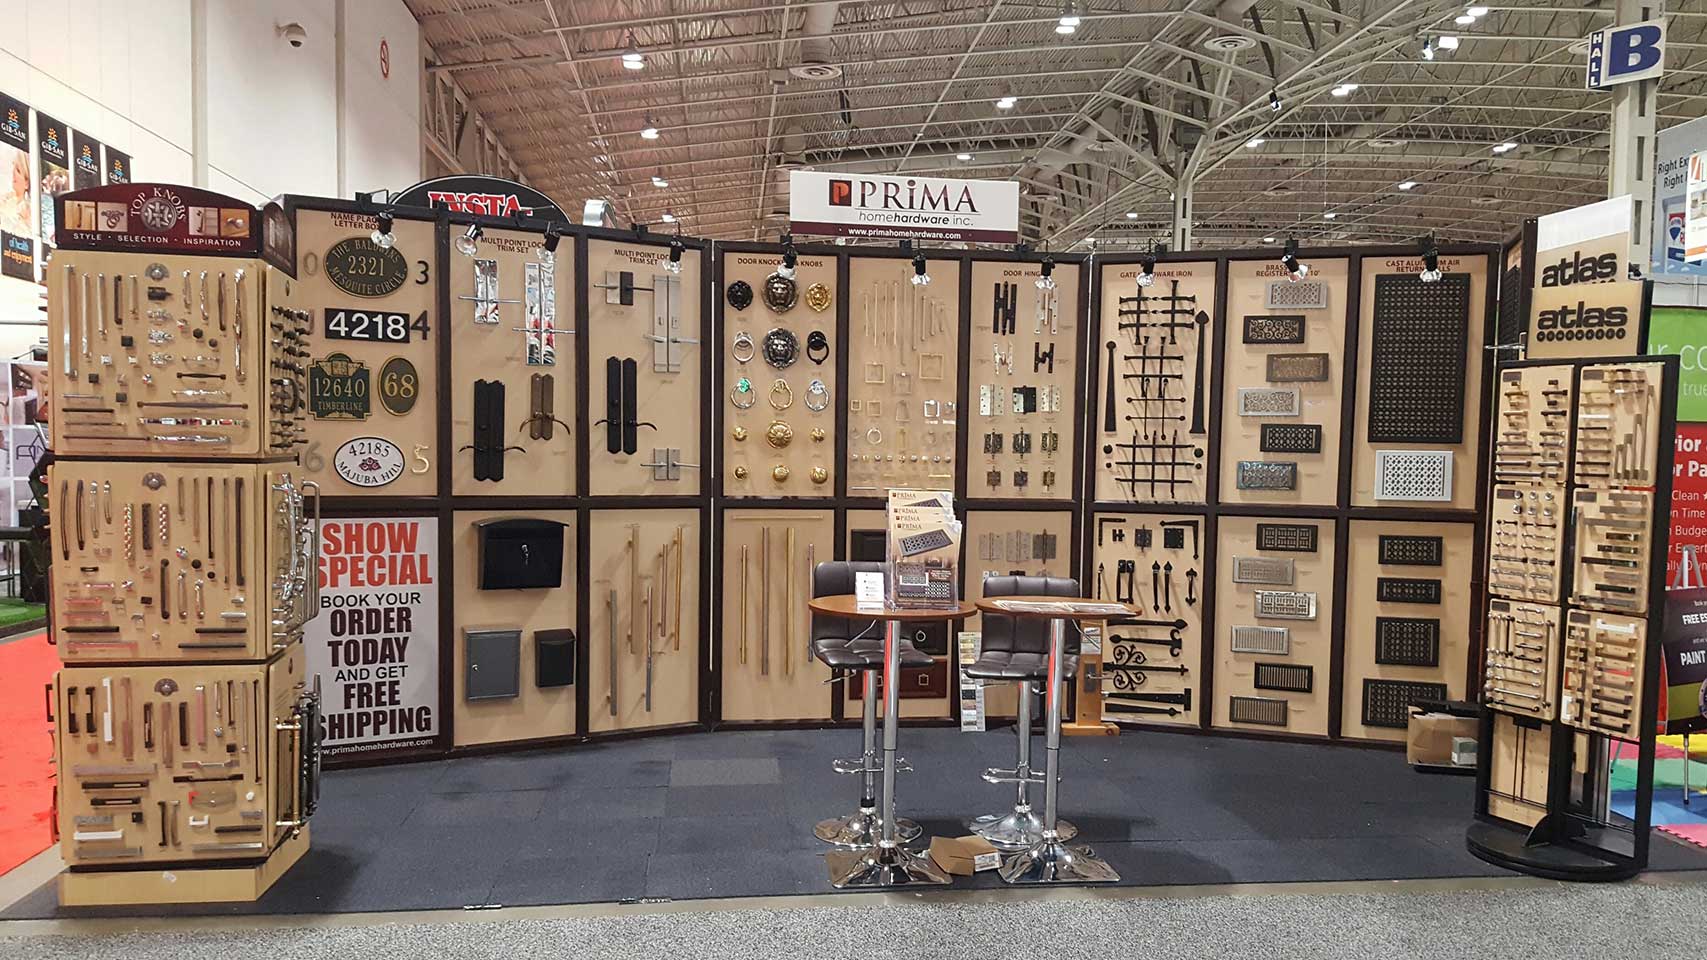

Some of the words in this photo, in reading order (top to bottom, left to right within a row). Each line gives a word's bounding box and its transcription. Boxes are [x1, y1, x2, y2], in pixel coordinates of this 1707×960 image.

[1590, 33, 1602, 86] HALL
[1608, 26, 1661, 76] B
[1658, 160, 1677, 175] Right
[1664, 173, 1683, 189] Right
[131, 192, 146, 217] TOP
[153, 187, 186, 220] KNOBS
[330, 212, 354, 221] NAME
[357, 215, 379, 224] PLAQ
[334, 220, 363, 229] LETTER
[859, 212, 950, 225] homehardware
[952, 215, 974, 226] inc.
[74, 233, 101, 241] STYLE
[118, 235, 168, 244] SELECTION
[184, 238, 241, 247] INSPIRATION
[480, 237, 502, 246] MULTI
[504, 239, 526, 247] POINT
[848, 228, 961, 240] www.primahomehardware.com
[332, 242, 350, 258] THE
[355, 239, 400, 263] BALDINS
[497, 245, 514, 253] TRIM
[516, 246, 529, 254] SET
[614, 249, 634, 257] MULTI
[636, 250, 655, 259] POINT
[348, 255, 384, 276] 2321
[416, 260, 429, 285] 3
[1024, 270, 1042, 278] HING
[1542, 251, 1617, 287] atlas
[375, 270, 405, 294] CIRCLE
[1537, 301, 1628, 330] atlas
[329, 311, 405, 340] 4218
[315, 378, 365, 397] 12640
[384, 372, 414, 398] 68
[318, 401, 363, 411] TIMBERLINE
[349, 442, 390, 458] 42185
[411, 444, 430, 474] 5
[338, 461, 378, 484] MAJUBA
[382, 462, 402, 481] HILL
[1672, 489, 1699, 501] Clean
[1681, 507, 1706, 518] Time
[322, 522, 419, 555] SHOW
[321, 594, 370, 608] BOOK
[375, 592, 421, 605] YOUR
[330, 607, 412, 637] ORDER
[1682, 613, 1700, 625] FREE
[327, 636, 409, 667] TODAY
[1680, 650, 1706, 666] PAINT
[335, 668, 370, 682] AND
[376, 665, 408, 679] GET
[344, 680, 401, 710] FREE
[321, 739, 433, 755] w.primahomehardware.com
